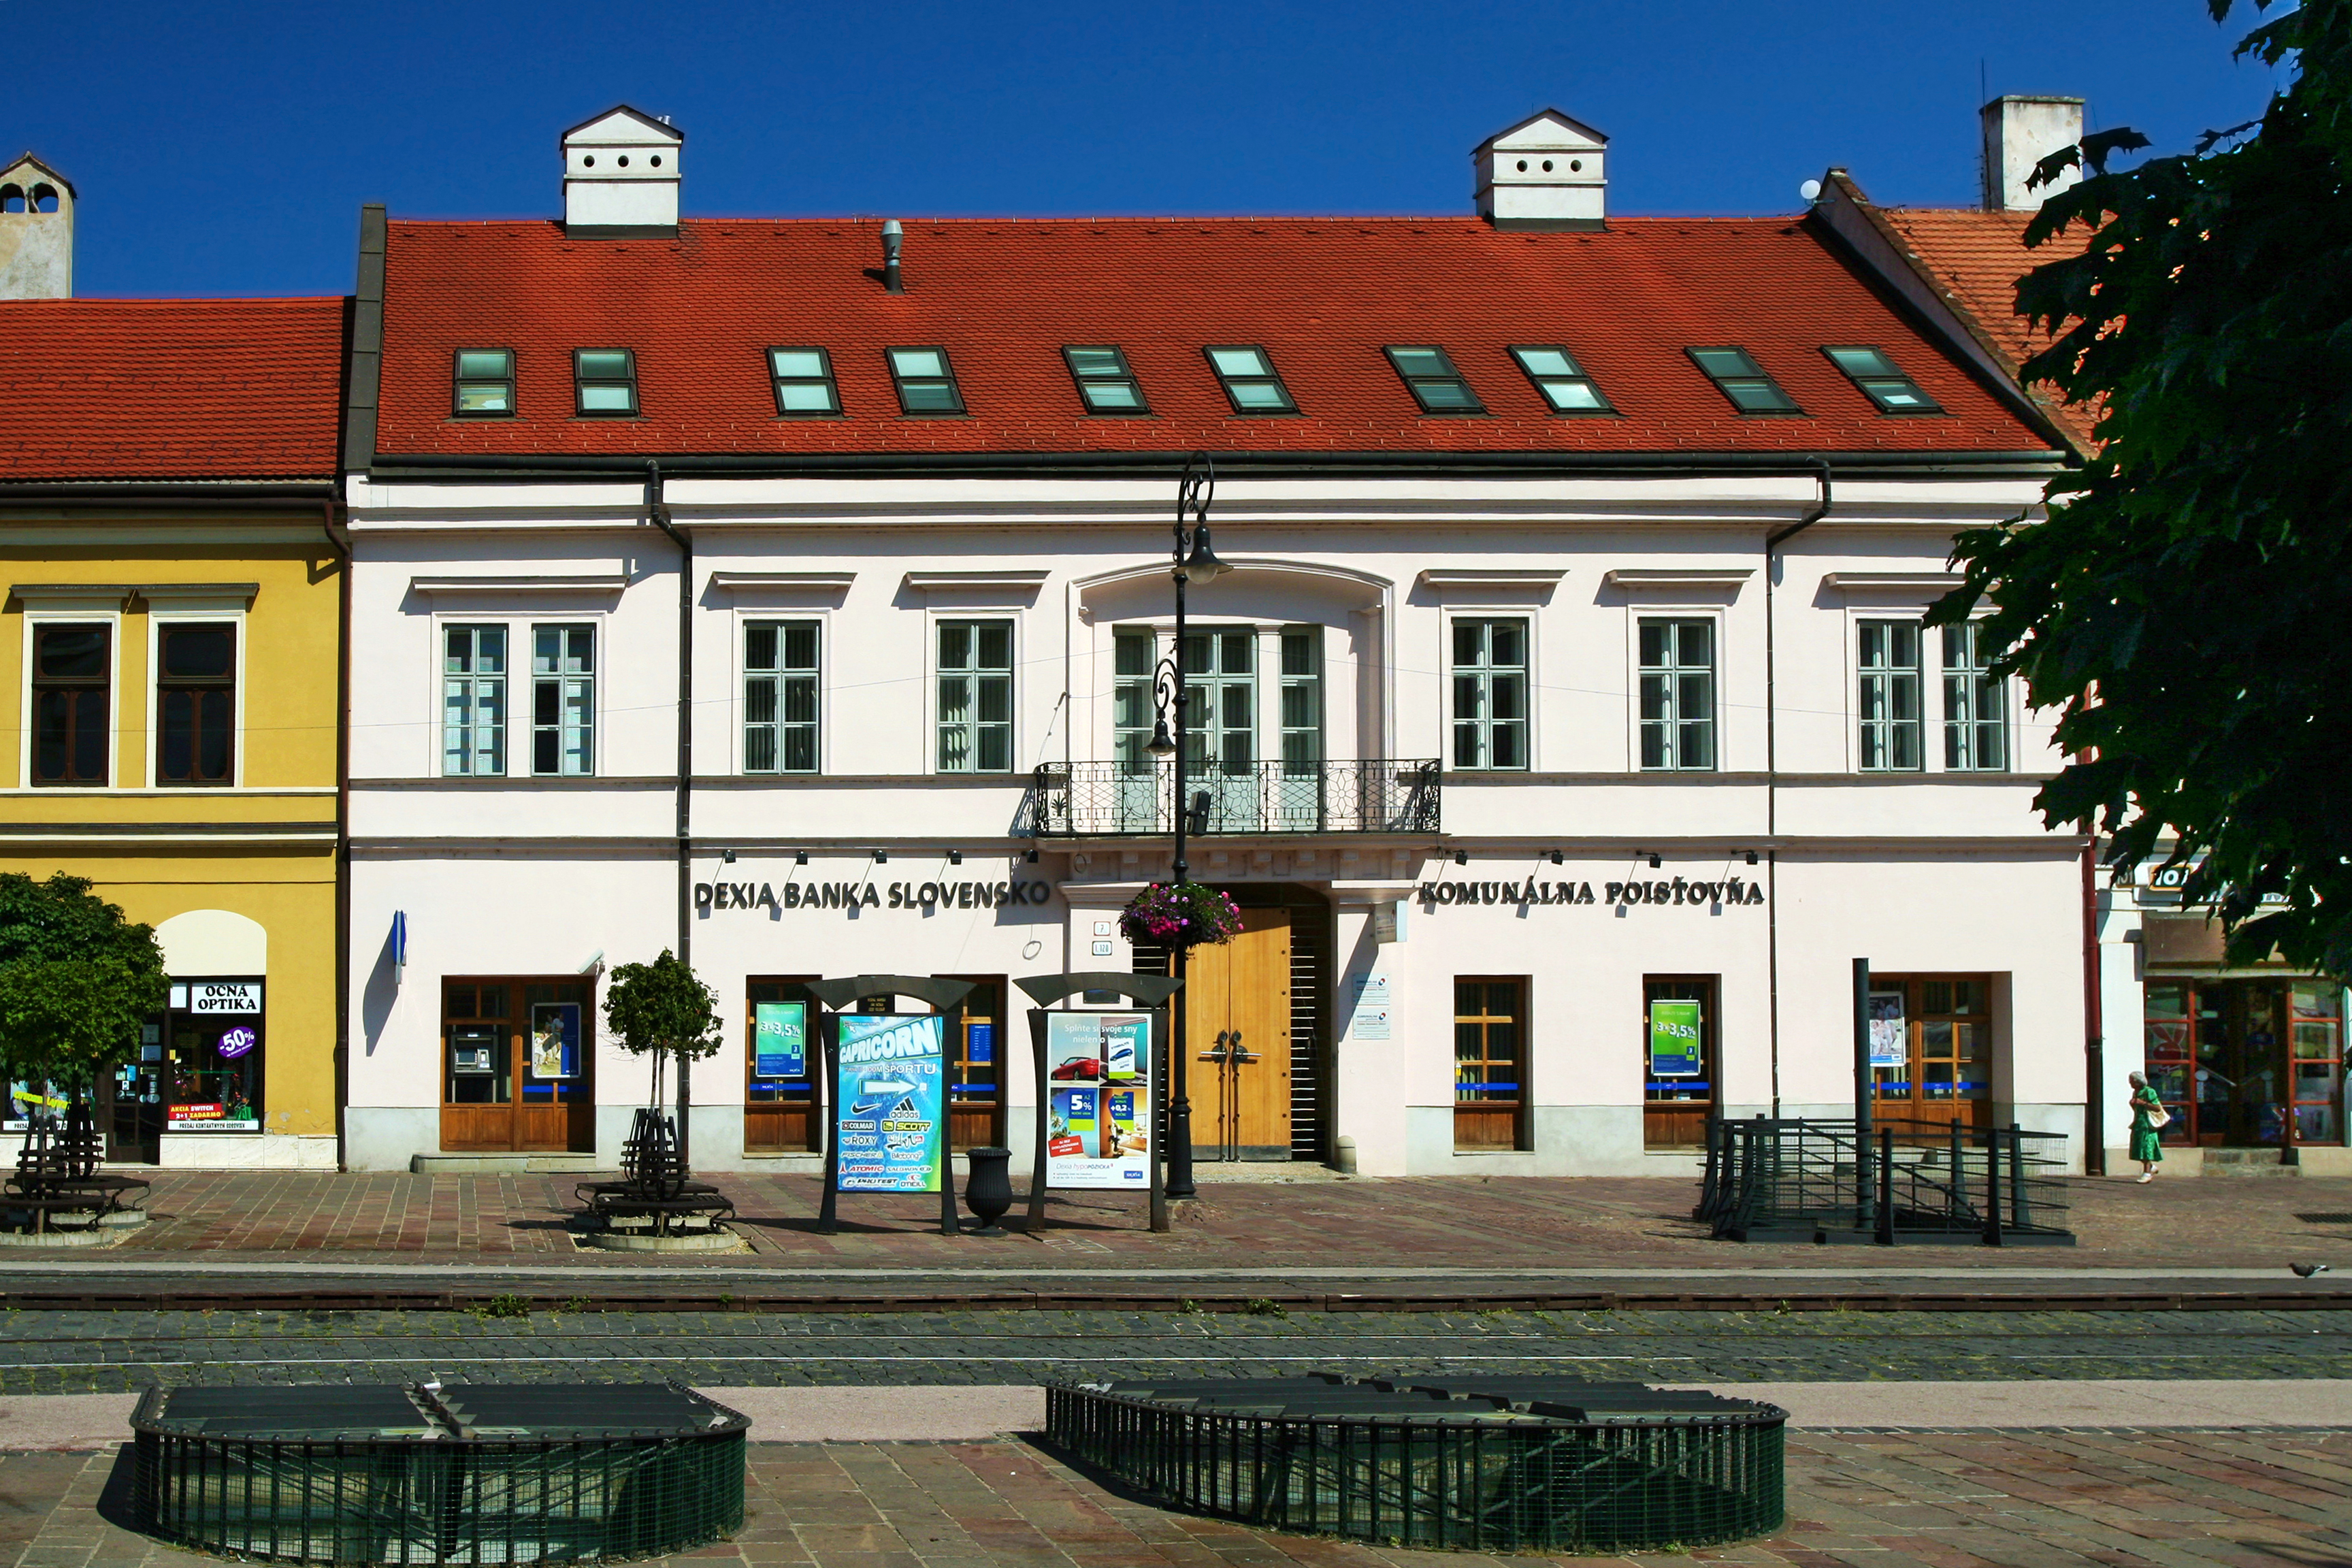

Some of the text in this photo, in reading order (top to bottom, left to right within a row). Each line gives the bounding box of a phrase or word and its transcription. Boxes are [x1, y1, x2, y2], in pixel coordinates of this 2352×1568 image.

[694, 881, 1050, 909] DEXIA BANKA SLOVENSKO
[1417, 875, 1765, 906] KOMUNÁLNA POISŤOVŇA
[205, 985, 248, 997] OČNÁ
[198, 998, 257, 1010] OPTIKA
[1101, 1024, 1122, 1034] svoje
[1124, 1026, 1138, 1034] sny
[220, 1029, 255, 1051] -50%
[840, 1017, 938, 1064] CAPRICORN
[1073, 1035, 1098, 1043] nielen
[885, 1063, 936, 1075] ŠPORTU
[896, 1123, 930, 1131] SCOTT
